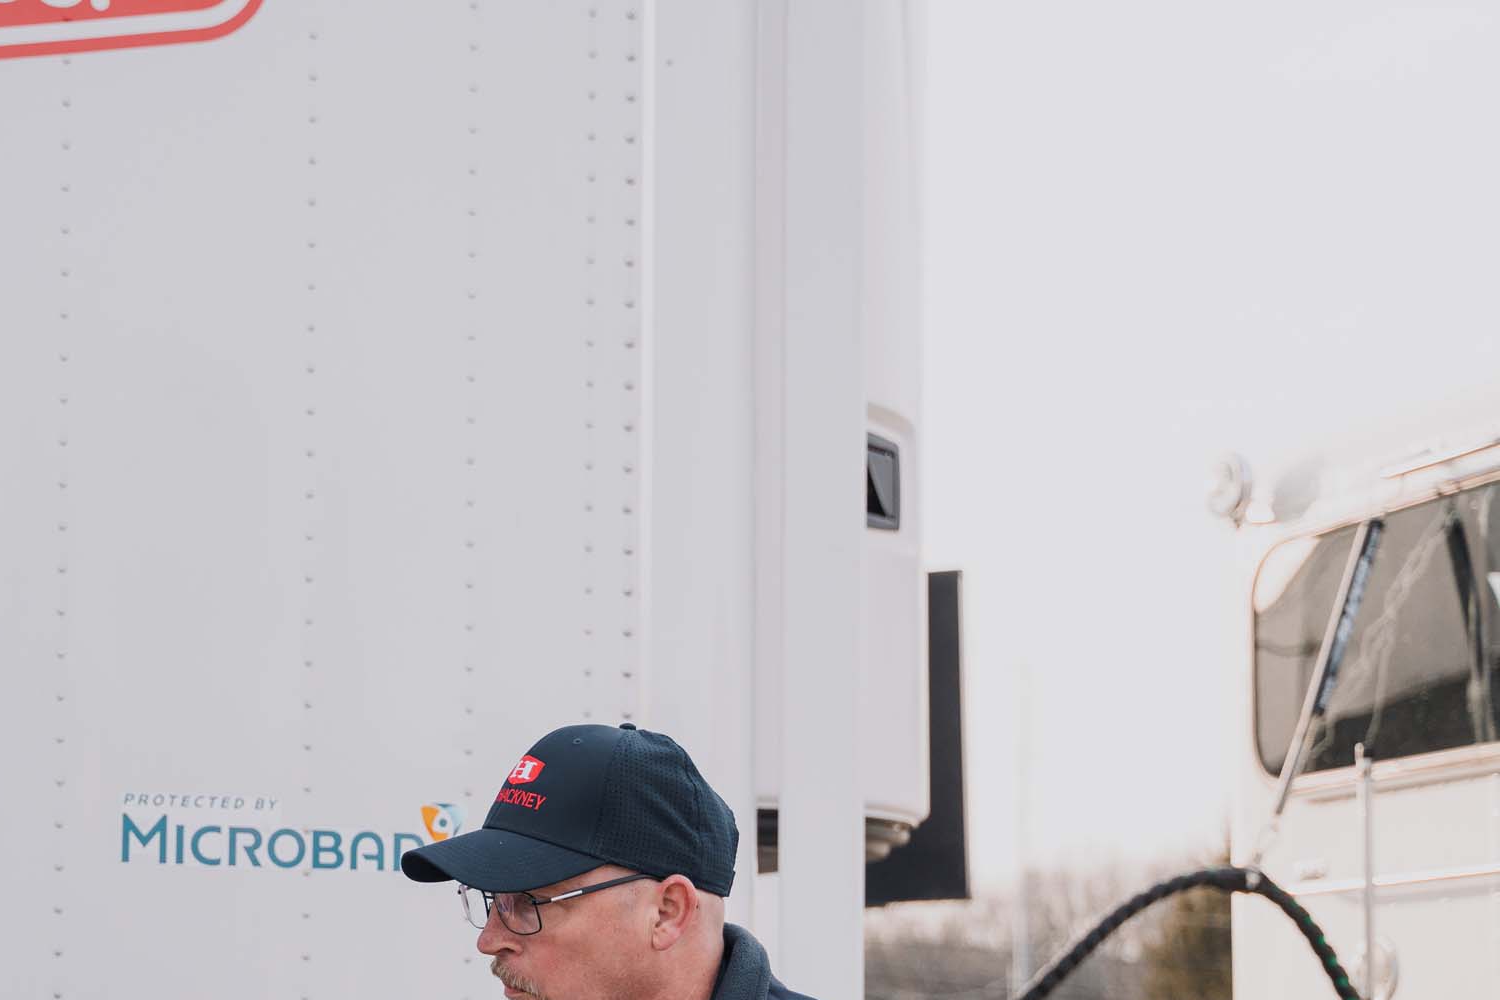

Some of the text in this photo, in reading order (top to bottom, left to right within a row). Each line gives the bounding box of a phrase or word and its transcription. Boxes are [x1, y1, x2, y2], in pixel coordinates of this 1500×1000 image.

[511, 759, 538, 780] H
[123, 792, 279, 811] PROTECTED BY
